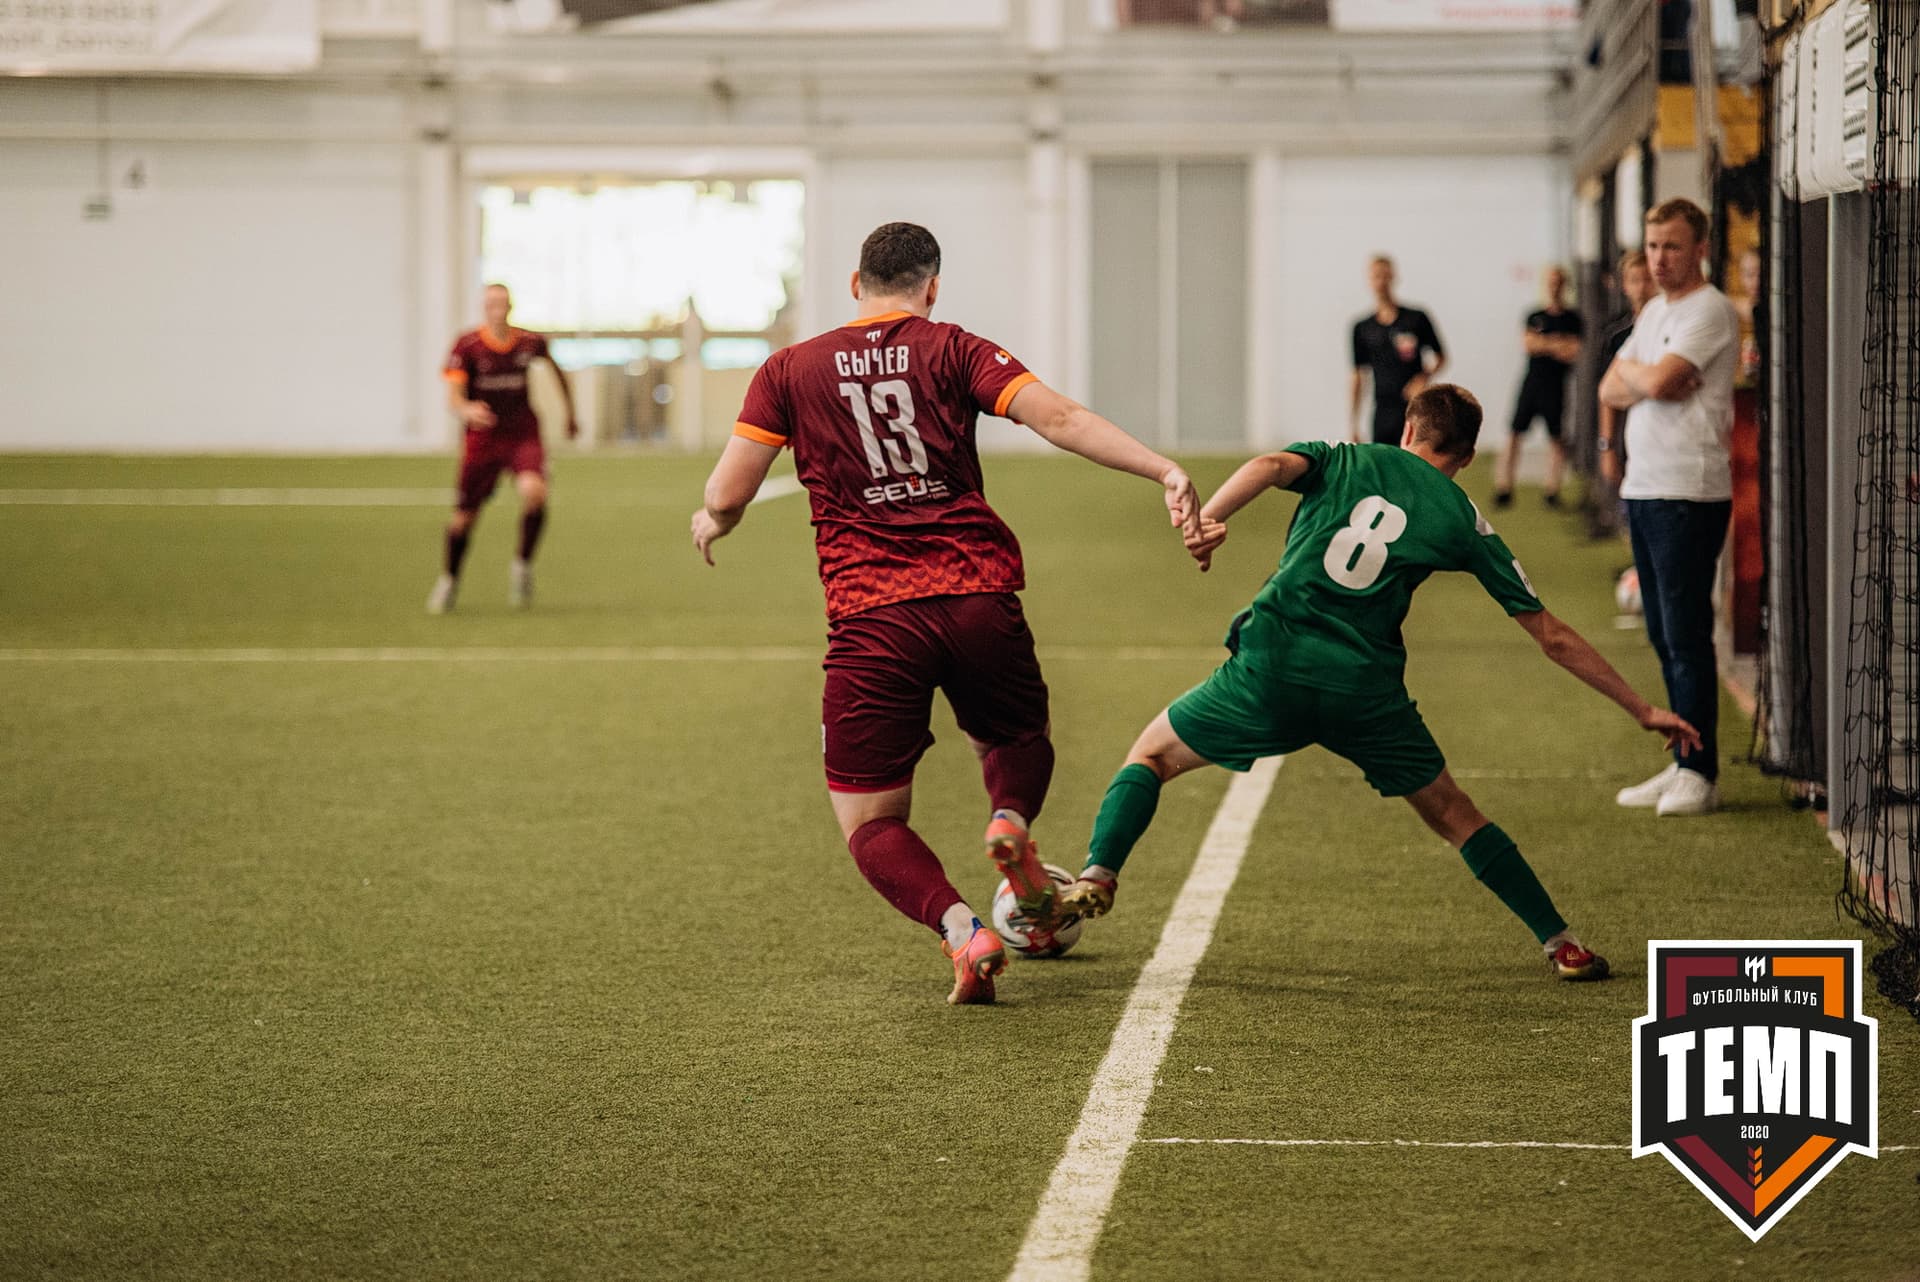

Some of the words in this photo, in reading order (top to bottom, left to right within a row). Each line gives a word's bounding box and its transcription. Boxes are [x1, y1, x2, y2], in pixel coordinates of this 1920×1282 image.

[834, 345, 910, 377] СЫЧЕВ
[838, 379, 929, 480] 13
[1323, 495, 1408, 590] 8
